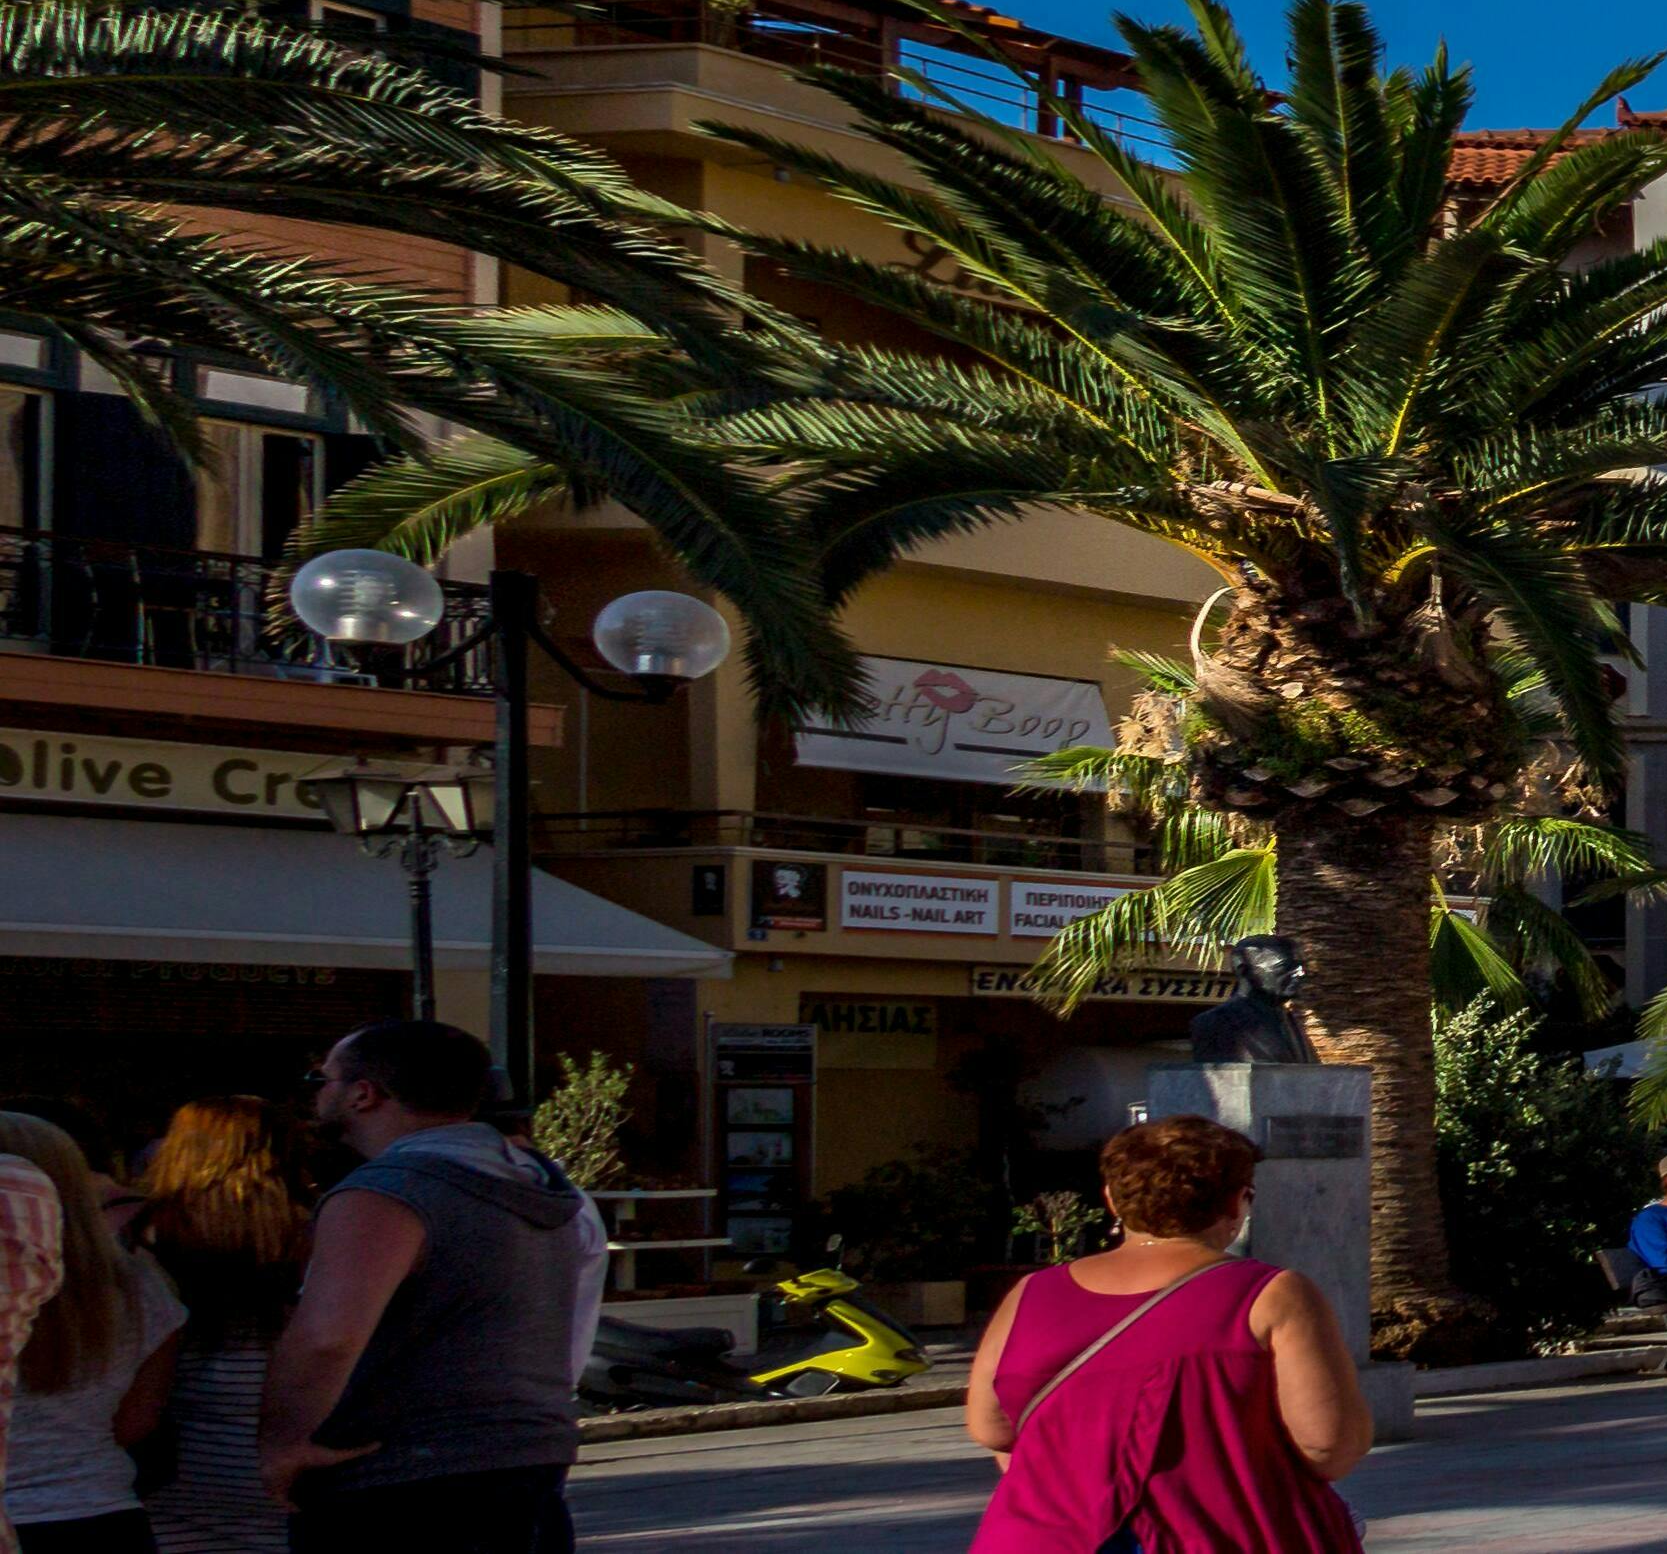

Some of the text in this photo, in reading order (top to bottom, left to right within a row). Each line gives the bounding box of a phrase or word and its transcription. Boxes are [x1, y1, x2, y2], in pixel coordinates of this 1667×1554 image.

[971, 696, 1091, 749] Boop
[847, 881, 989, 903] ΟΝΥΧΟΠΛΑΣΤΙΚΗ
[849, 904, 900, 921] NAILS
[953, 909, 986, 926] ART
[1014, 912, 1064, 928] FACIAL
[805, 1003, 932, 1034] ΛΗΣΙΑΣ
